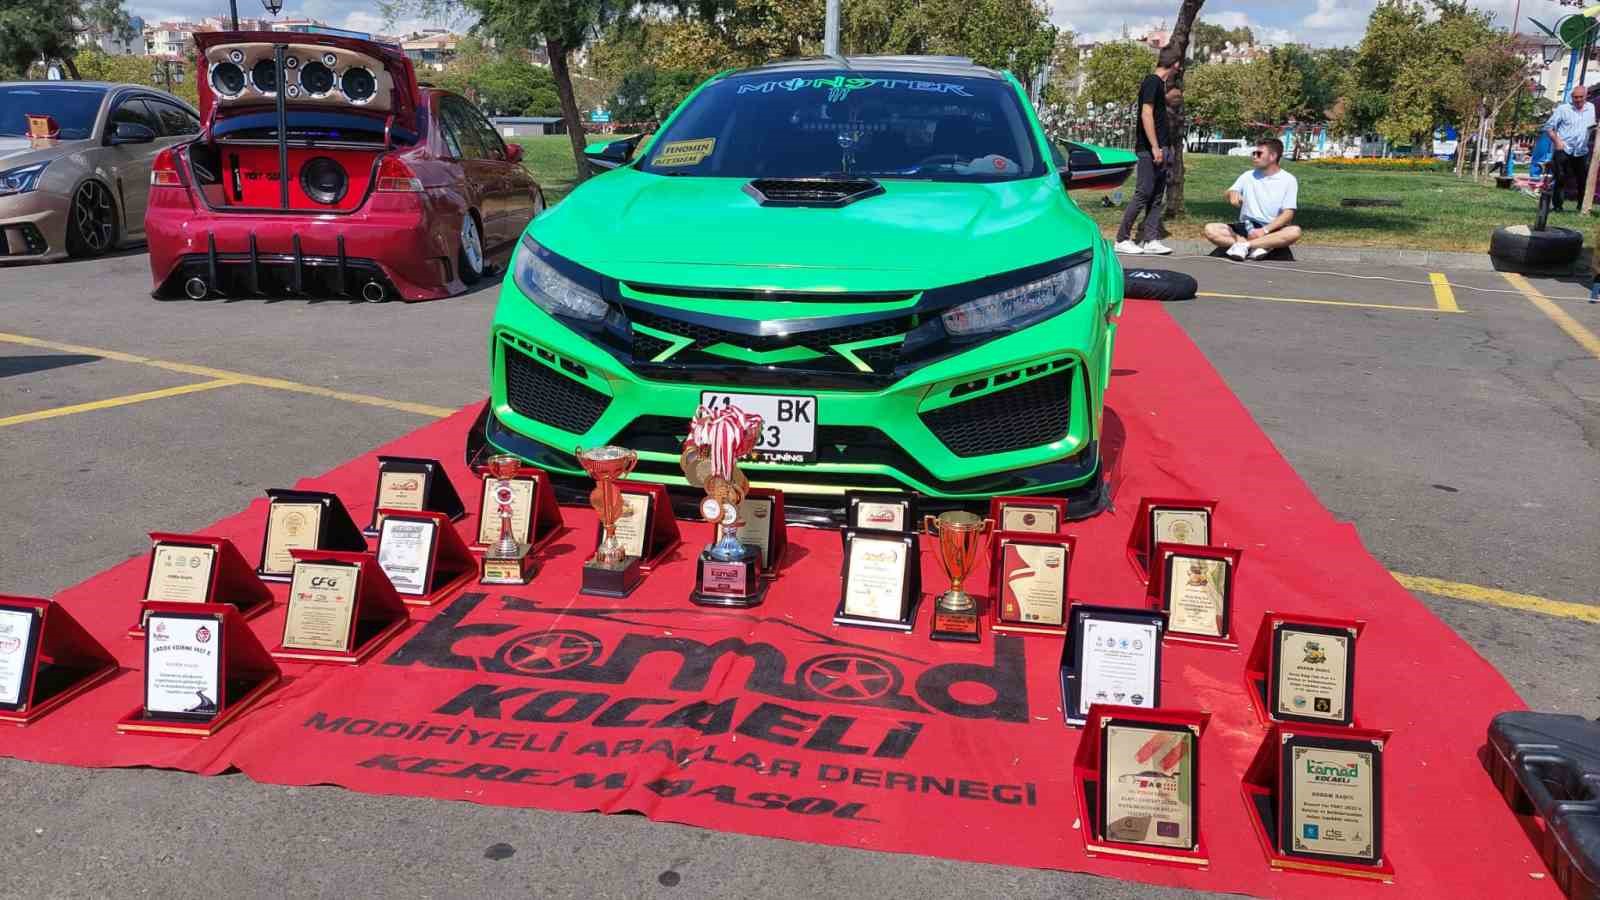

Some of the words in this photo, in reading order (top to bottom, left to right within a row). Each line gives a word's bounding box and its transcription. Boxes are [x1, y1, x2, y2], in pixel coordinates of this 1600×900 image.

[777, 399, 811, 423] BK
[311, 577, 337, 588] CFG
[355, 754, 628, 790] KEREM
